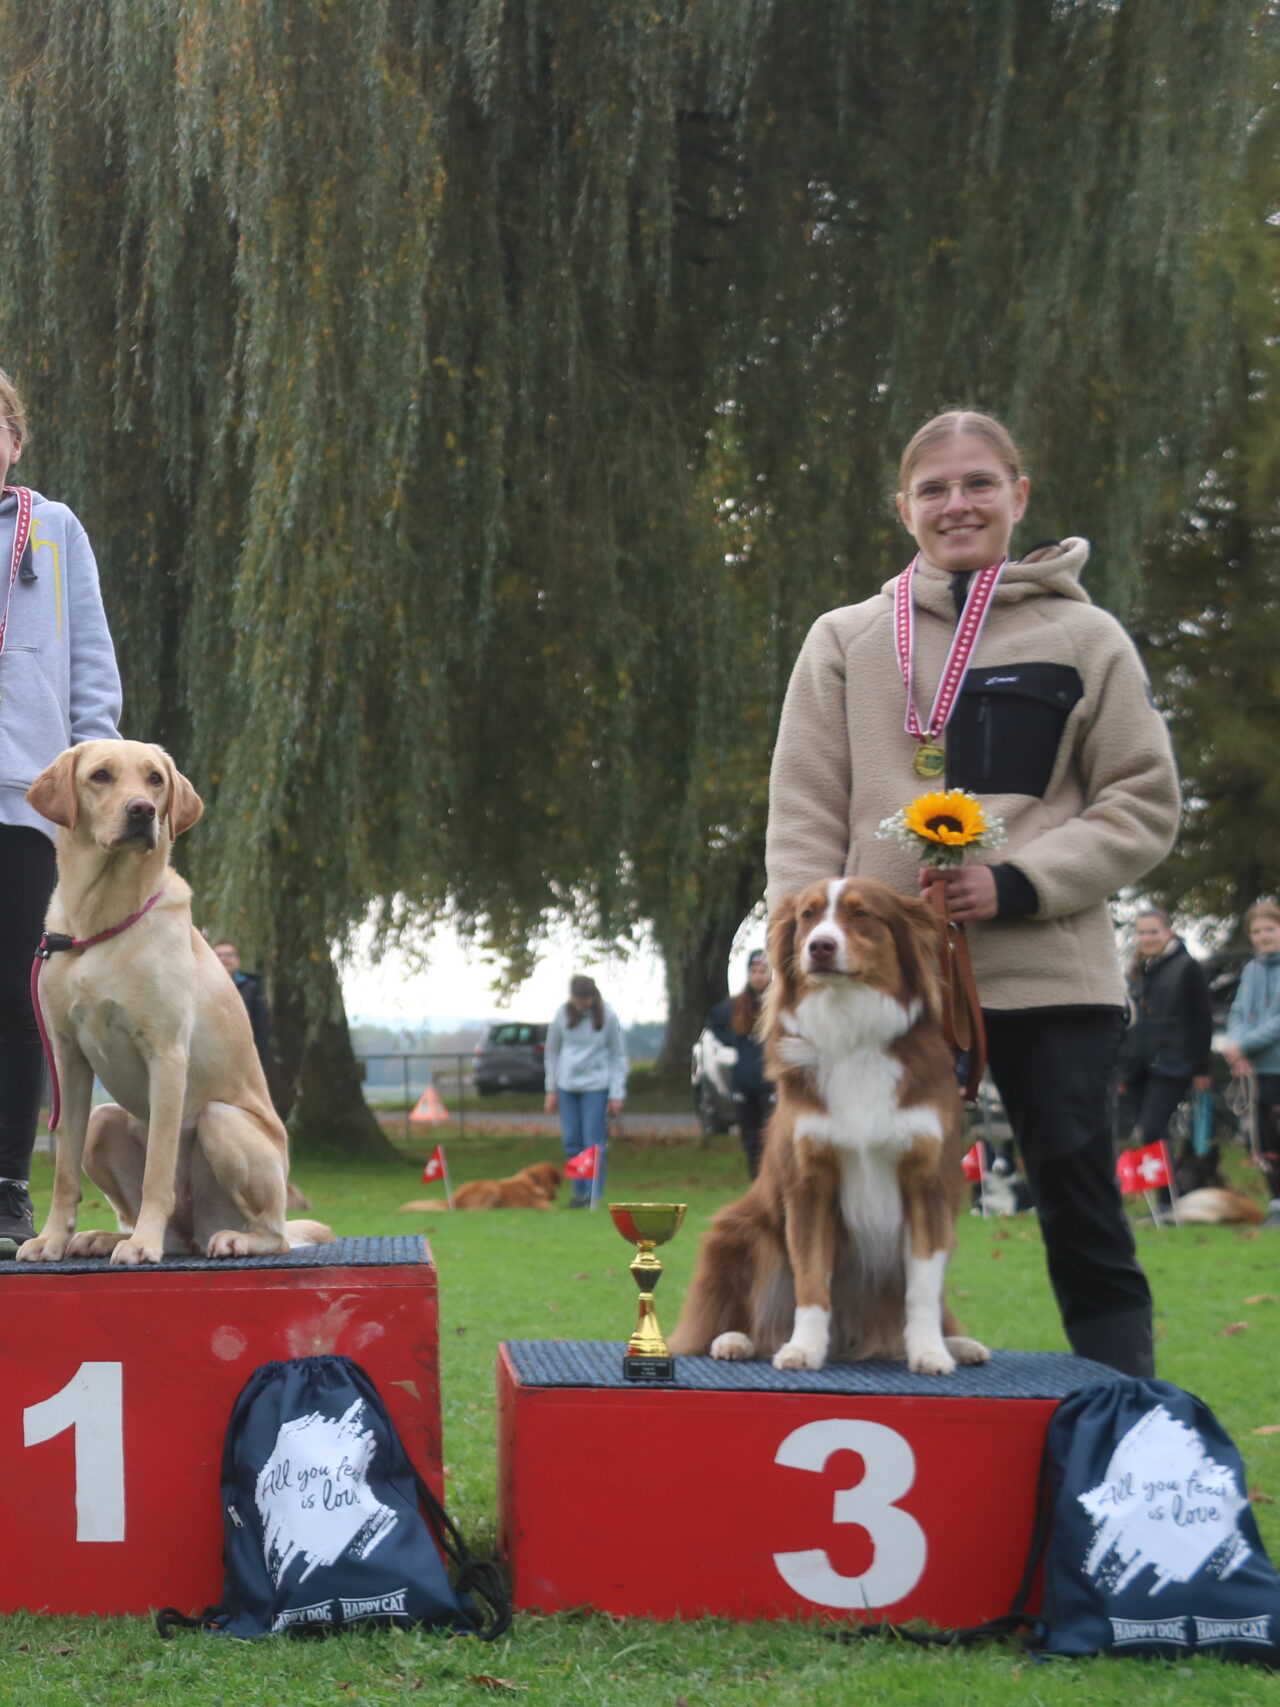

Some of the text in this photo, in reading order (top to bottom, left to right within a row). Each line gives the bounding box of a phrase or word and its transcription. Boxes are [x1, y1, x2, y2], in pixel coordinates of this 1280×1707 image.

[23, 1361, 125, 1542] 1
[262, 1458, 291, 1500] All
[298, 1465, 330, 1492] you
[1098, 1470, 1226, 1505] All you feed
[301, 1494, 315, 1509] is
[773, 1418, 927, 1609] 3
[1148, 1493, 1220, 1527] is love
[307, 1605, 332, 1622] DOG
[341, 1593, 406, 1619] HAPPY CAT
[1111, 1621, 1187, 1641] HAPPY DOG
[1195, 1620, 1269, 1640] HAPPY CAT
